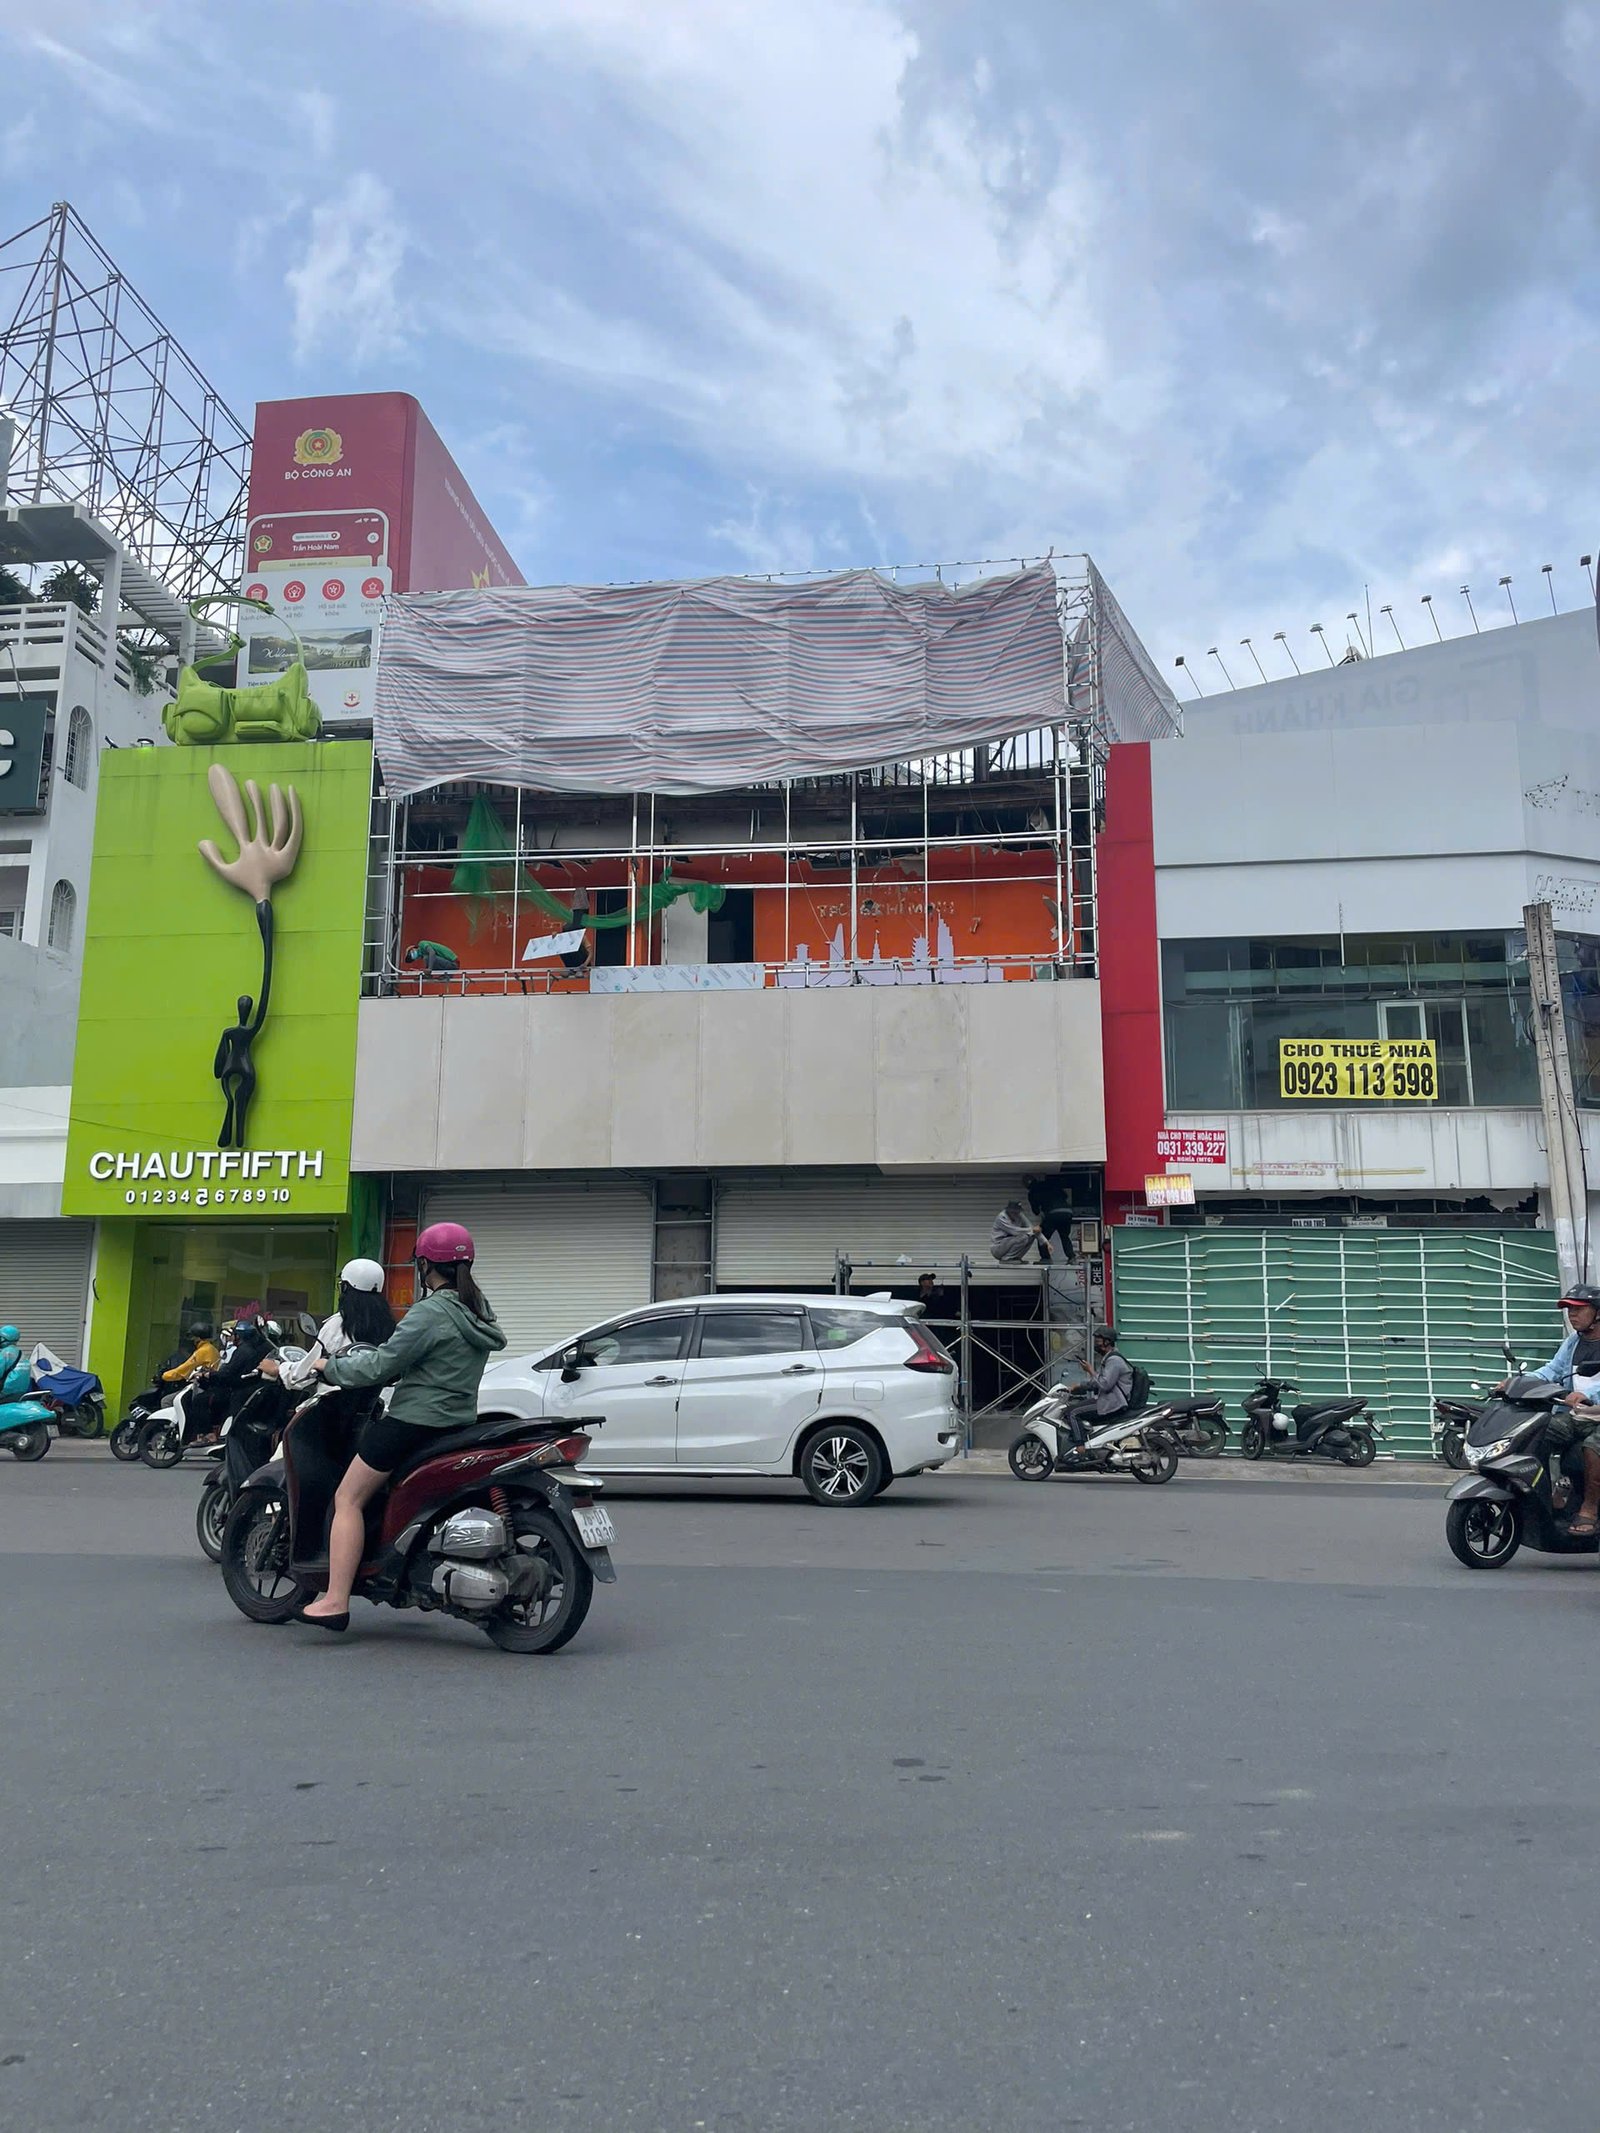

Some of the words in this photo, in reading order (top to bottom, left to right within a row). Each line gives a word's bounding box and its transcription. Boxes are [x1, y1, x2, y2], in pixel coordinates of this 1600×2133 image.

[284, 469, 300, 481] BỘ
[301, 468, 335, 479] CÔNG
[335, 467, 352, 477] AN
[323, 543, 340, 551] Nam
[1283, 1044, 1324, 1057] CHO
[1331, 1042, 1382, 1058] THUÊ
[1389, 1042, 1432, 1058] NHÀ
[1284, 1062, 1338, 1096] 0923
[1345, 1063, 1386, 1096] 113
[1393, 1063, 1434, 1096] 598
[1170, 1131, 1182, 1140] CHO
[1157, 1141, 1225, 1156] 0931.339.227
[89, 1150, 323, 1179] CHAUTFIFTH
